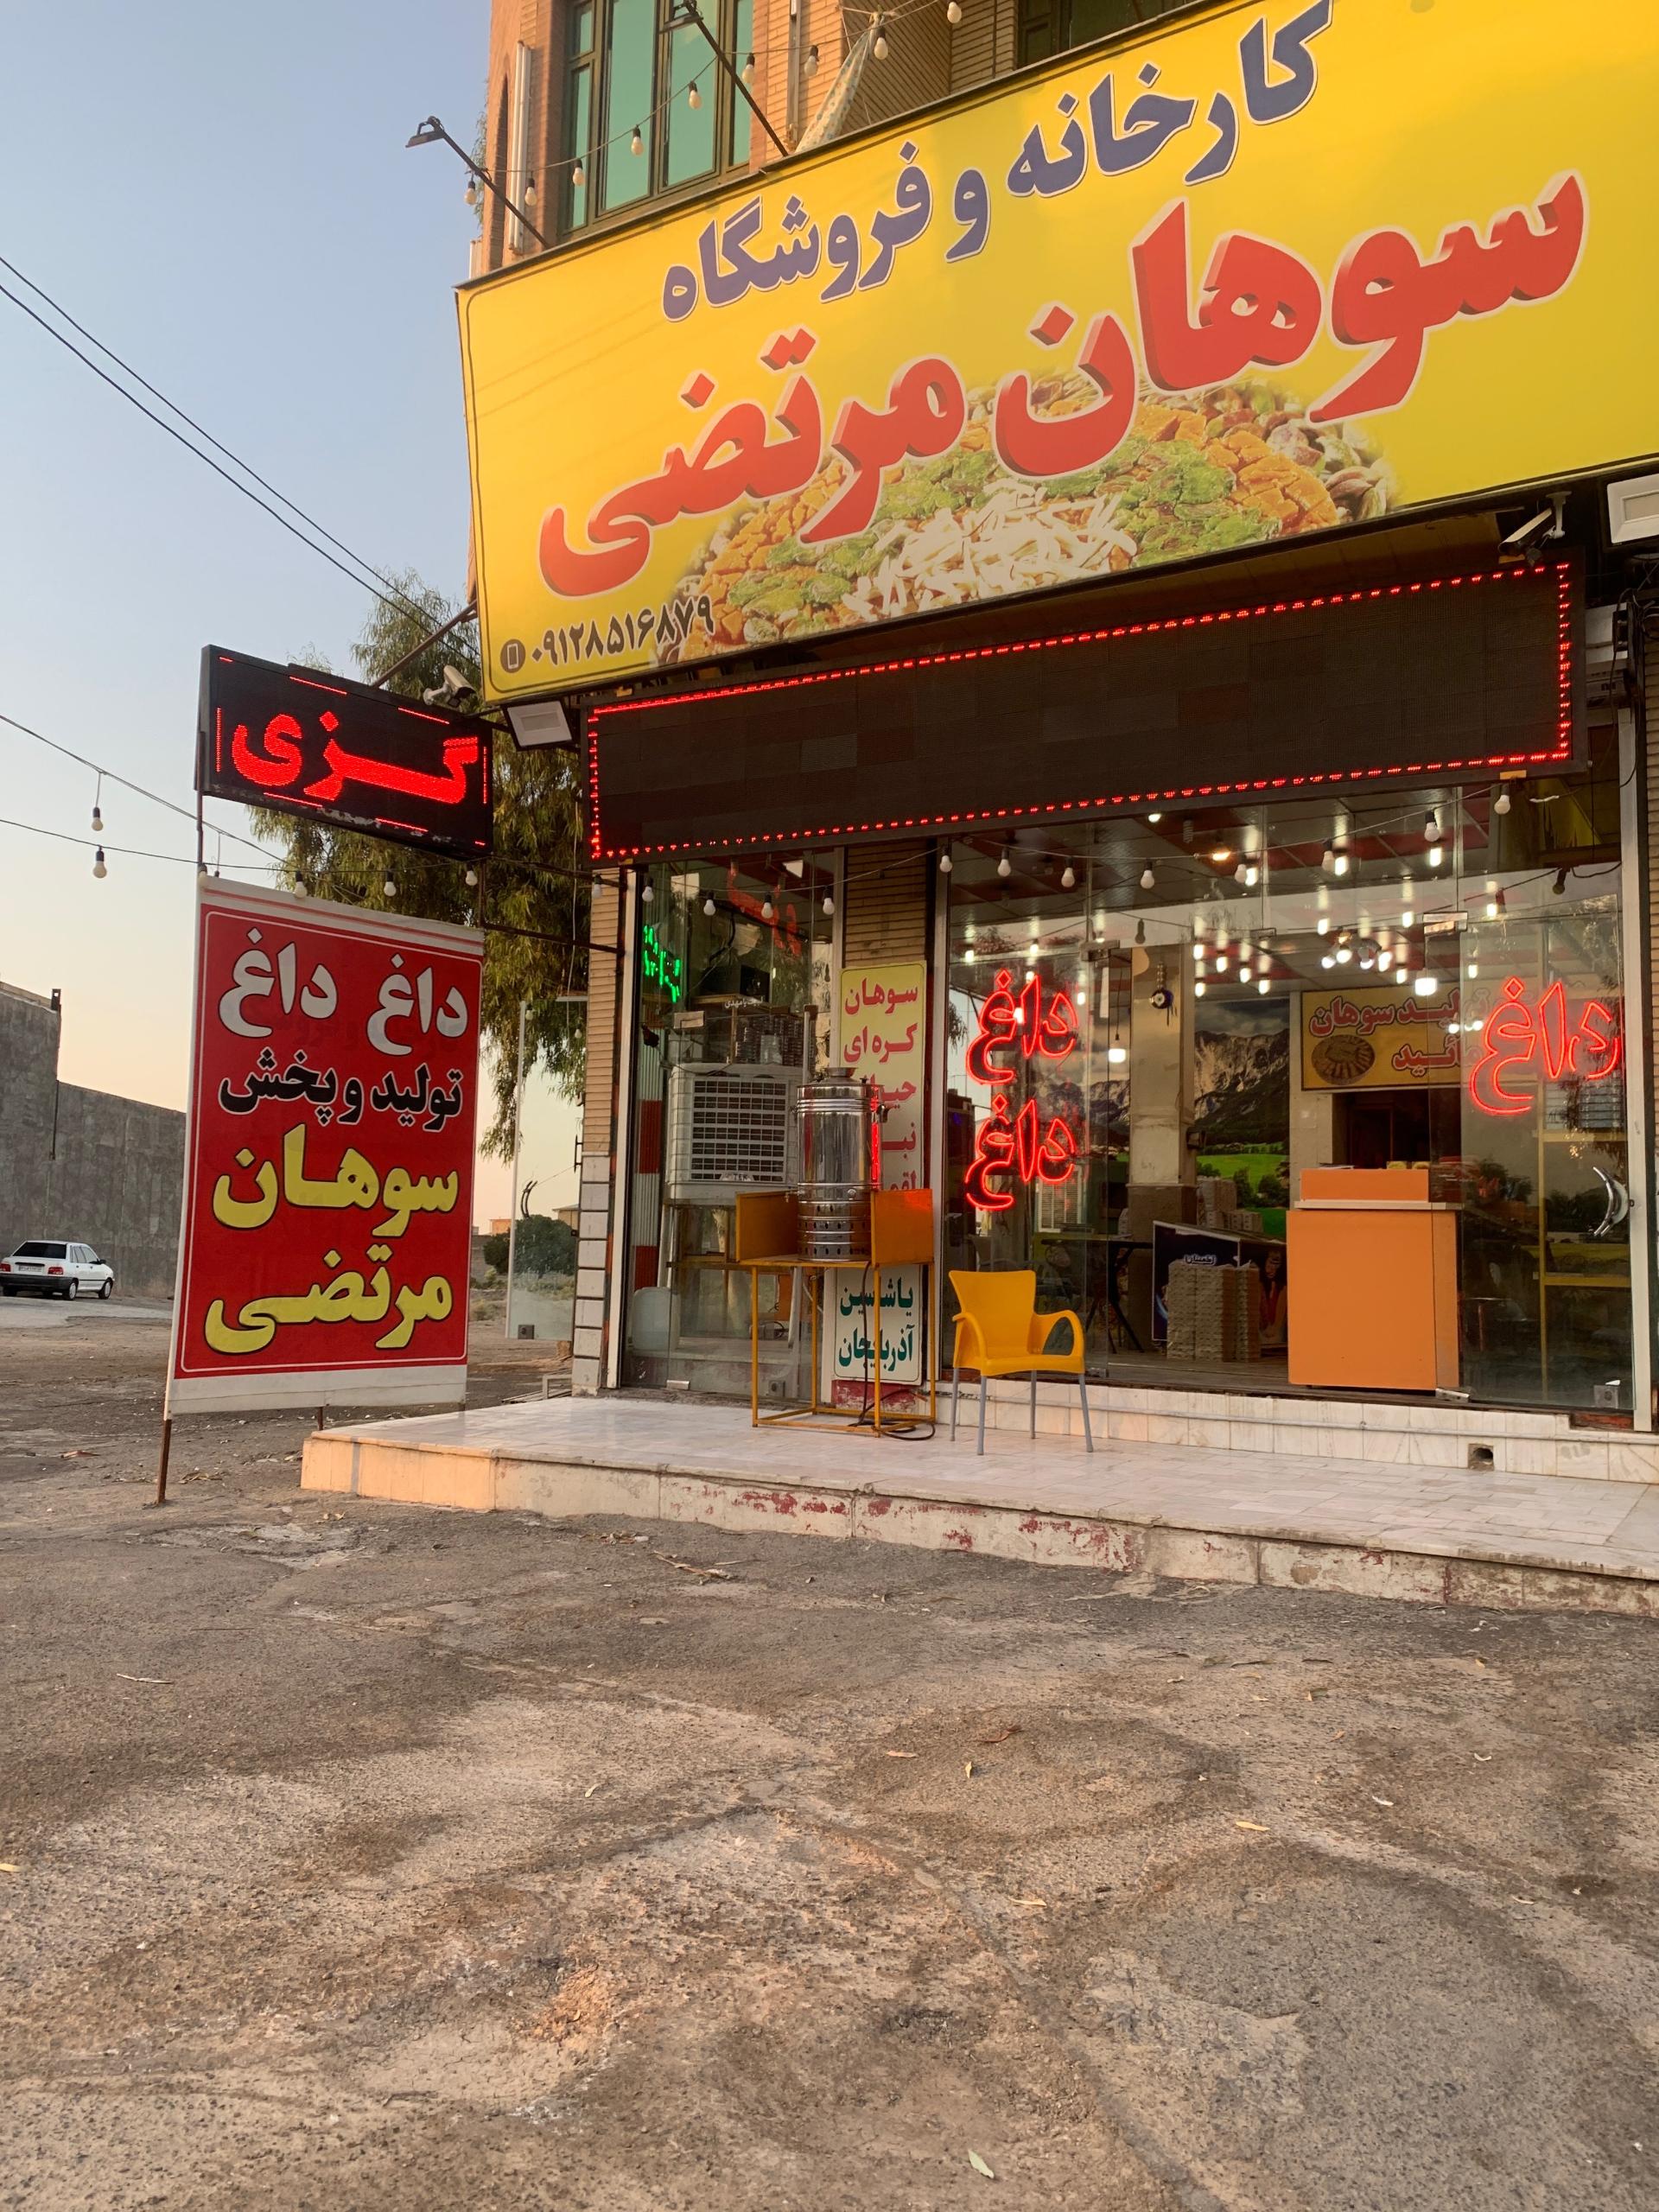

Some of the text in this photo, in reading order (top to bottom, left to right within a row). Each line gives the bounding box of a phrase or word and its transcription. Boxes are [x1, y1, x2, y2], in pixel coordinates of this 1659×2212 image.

[662, 0, 1336, 323] کارخانه و فروشگاه
[537, 169, 1590, 600] سوهان مرتضی
[531, 594, 715, 666] ۰۹۱۲۸۵۱۶۸۷۹
[218, 926, 468, 1057] داغ داغ
[843, 1022, 918, 1064] کره ای
[844, 977, 918, 1015] سوهان
[965, 968, 1078, 1085] داغ
[1308, 995, 1395, 1037] سوهان
[1468, 975, 1622, 1116] داغ
[218, 1046, 464, 1133] تولید و پخش
[213, 1122, 460, 1237] سوهان
[963, 1092, 1077, 1211] داغ
[204, 1243, 454, 1354] مرتضی
